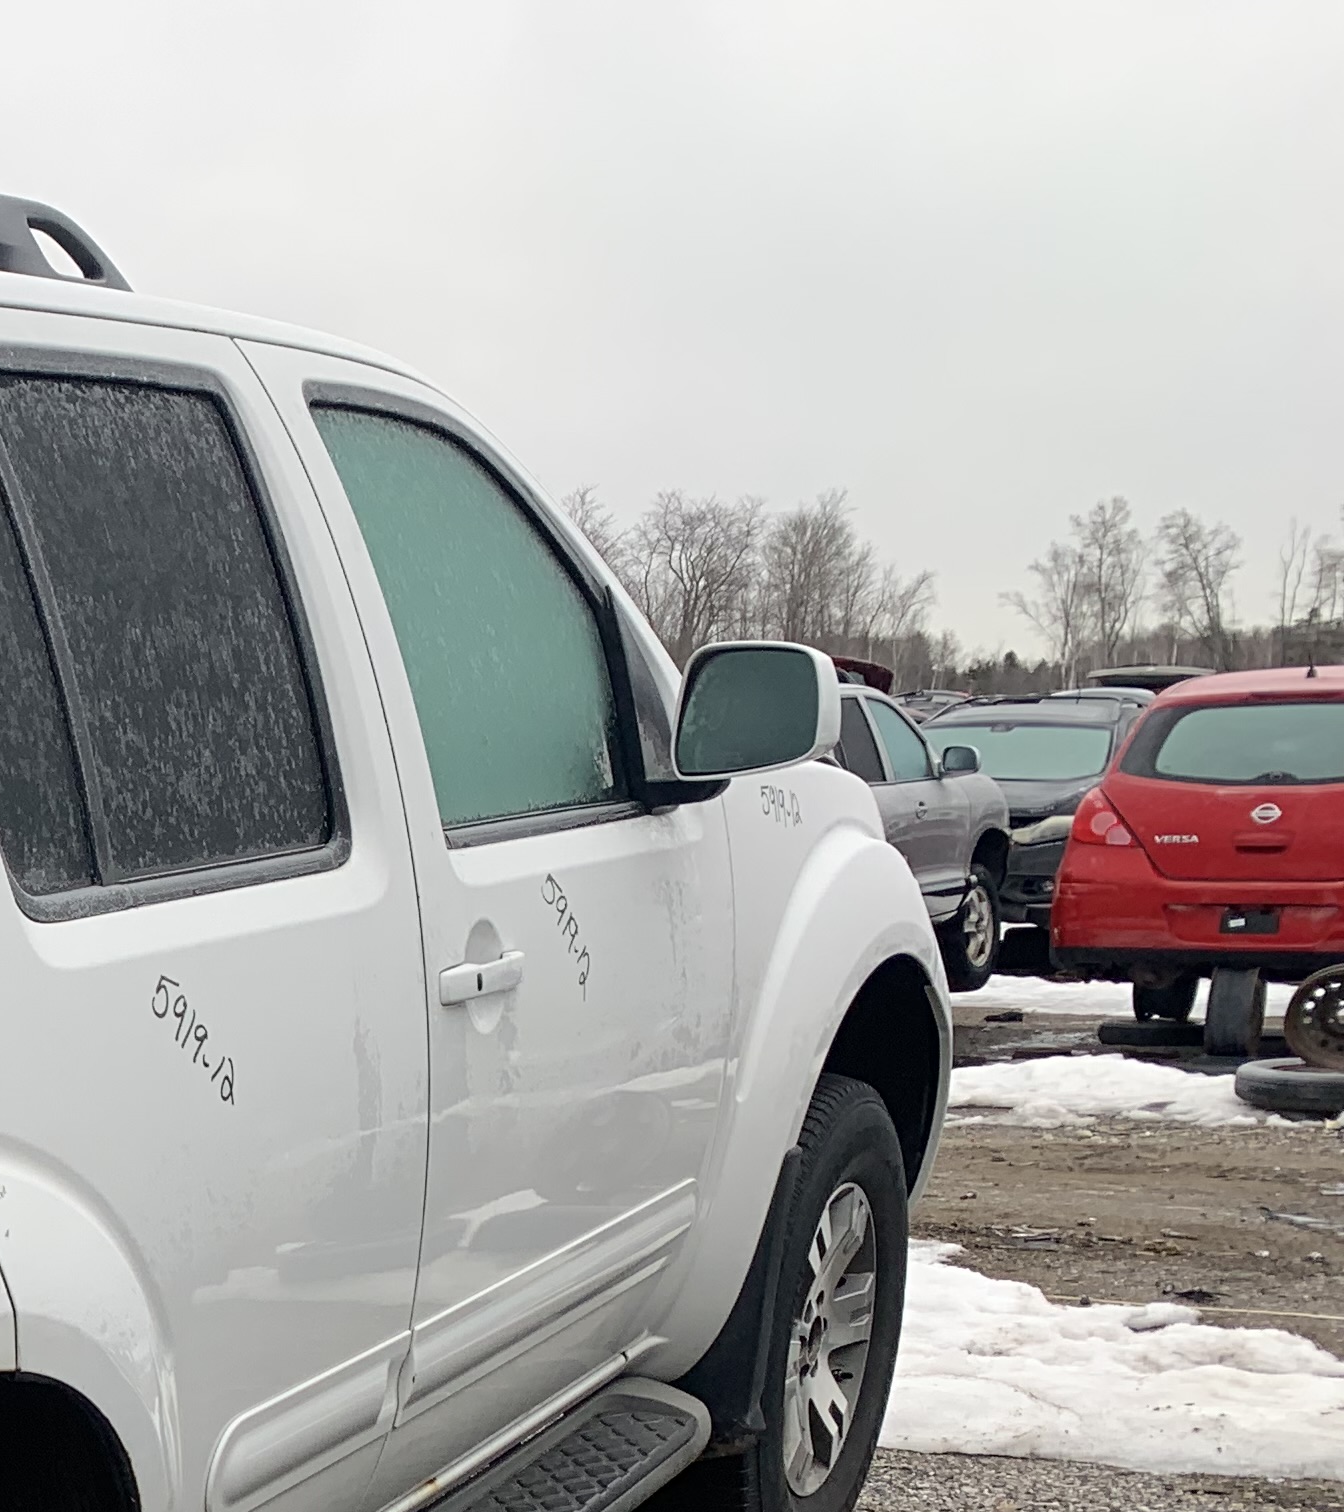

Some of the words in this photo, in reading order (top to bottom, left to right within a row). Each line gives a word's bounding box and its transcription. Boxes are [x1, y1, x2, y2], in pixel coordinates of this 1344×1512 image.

[760, 785, 803, 829] 5919-12
[1154, 834, 1200, 844] VERSA
[151, 974, 235, 1106] 5919-12
